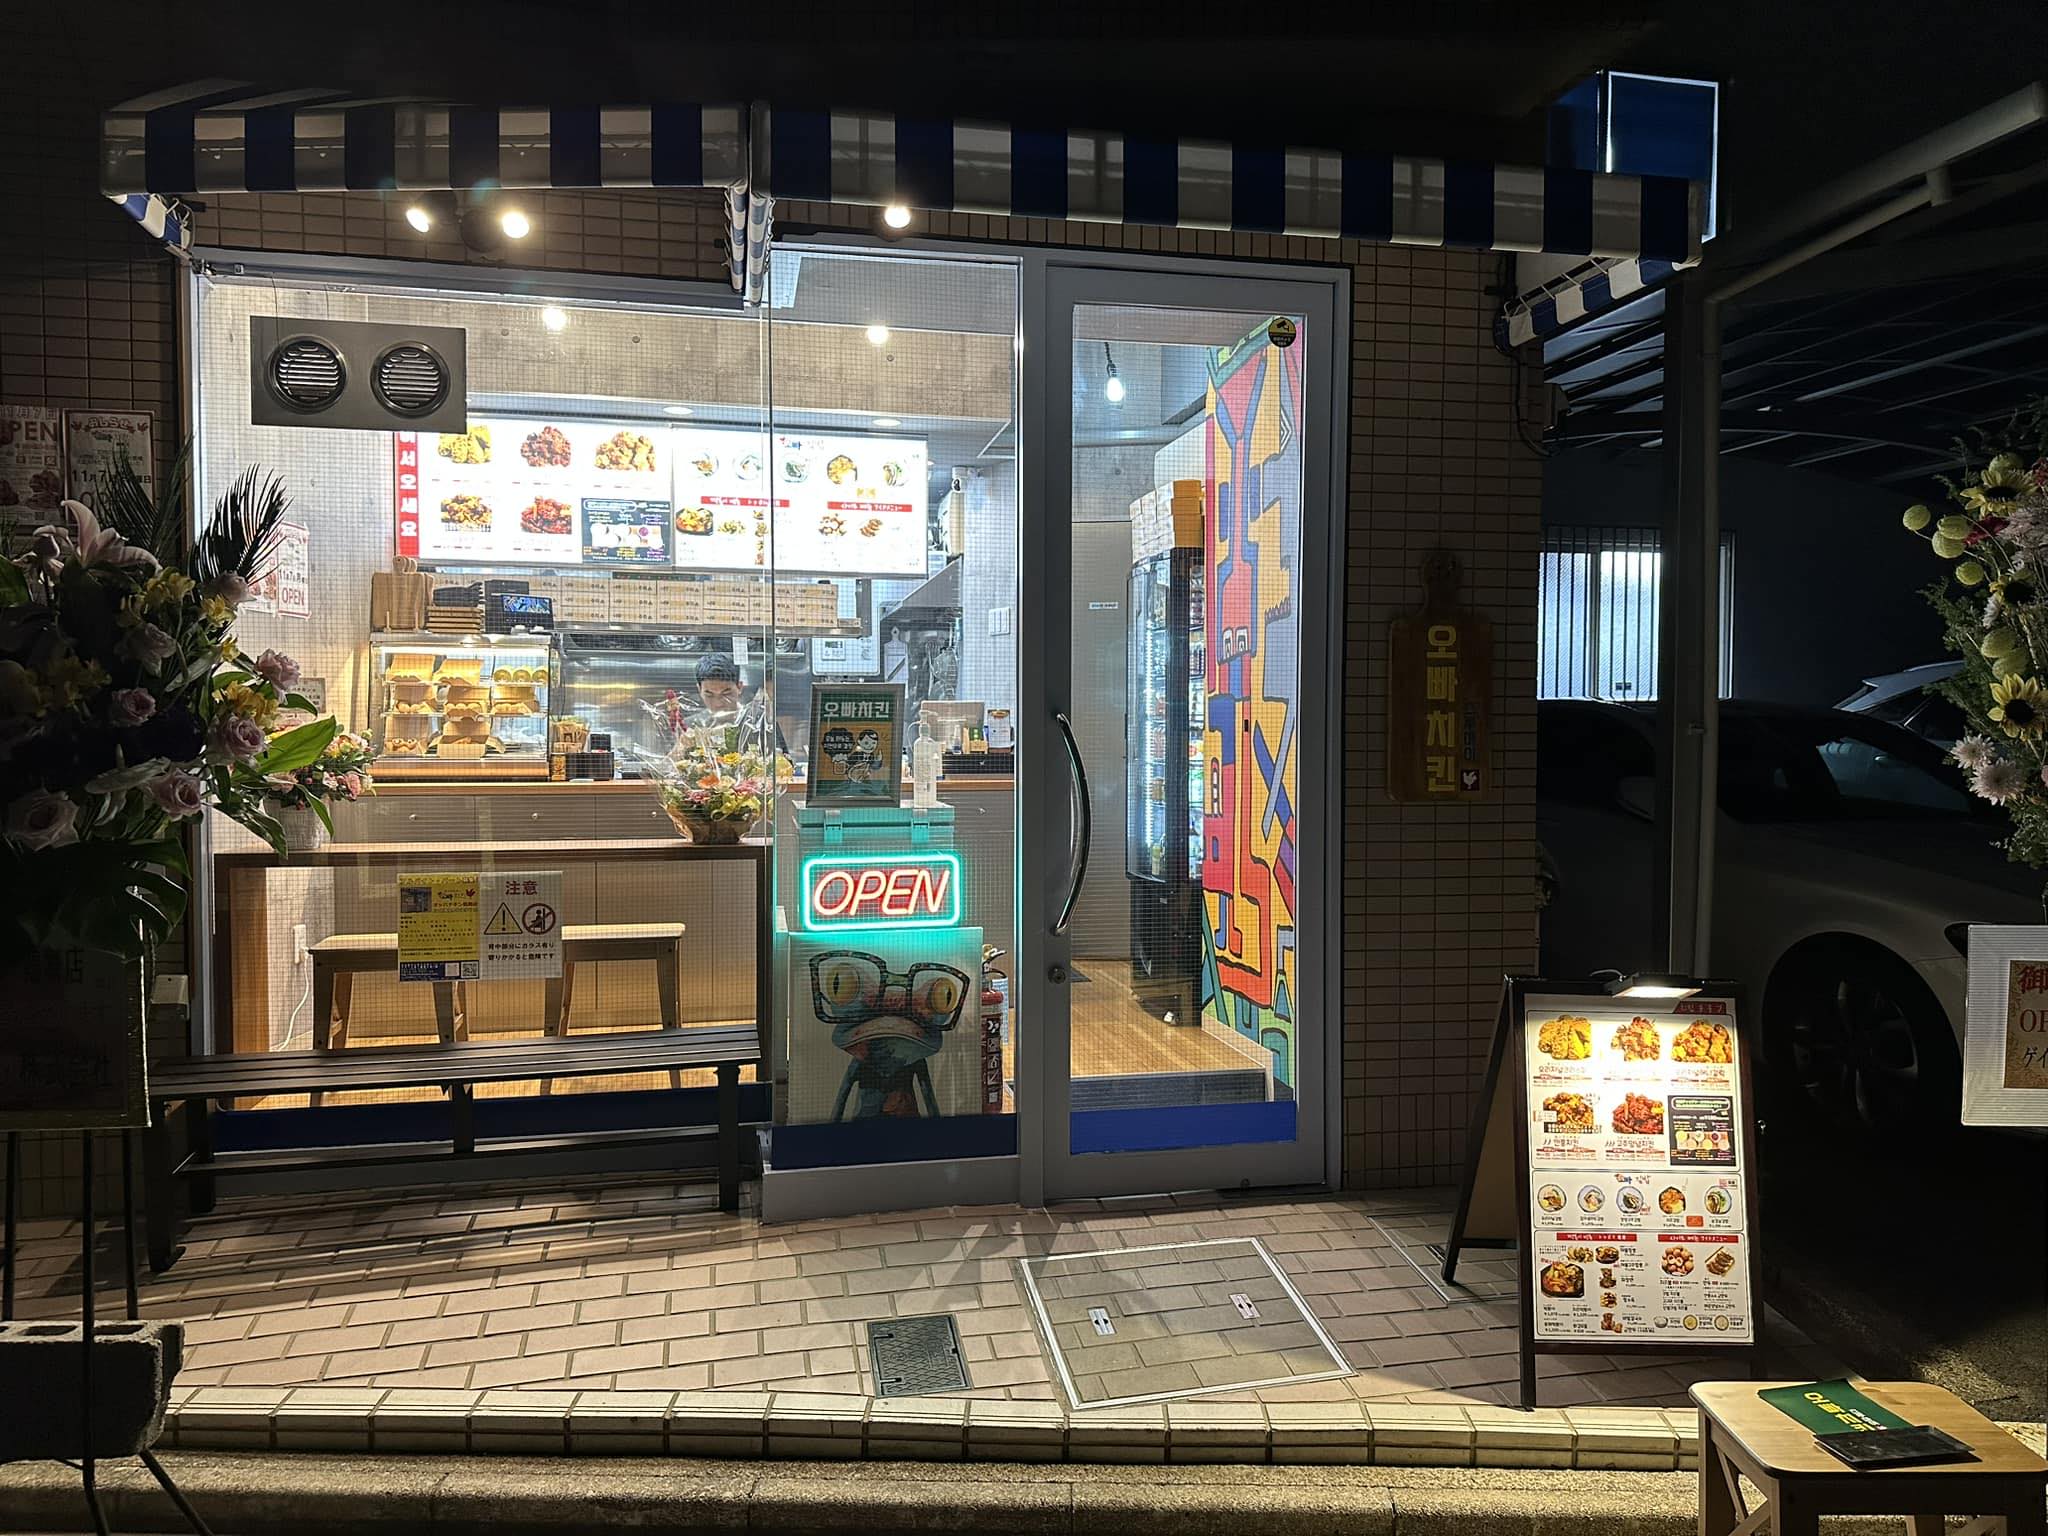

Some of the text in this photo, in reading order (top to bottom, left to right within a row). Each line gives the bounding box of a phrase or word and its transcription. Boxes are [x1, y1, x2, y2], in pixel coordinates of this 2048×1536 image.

[282, 587, 305, 606] OPEN
[823, 701, 889, 719] 오빠치킨
[1425, 624, 1458, 793] 오빠치킨
[505, 880, 538, 896] 注意
[812, 868, 951, 917] OPEN
[488, 942, 554, 951] 背中部分にガラス有り
